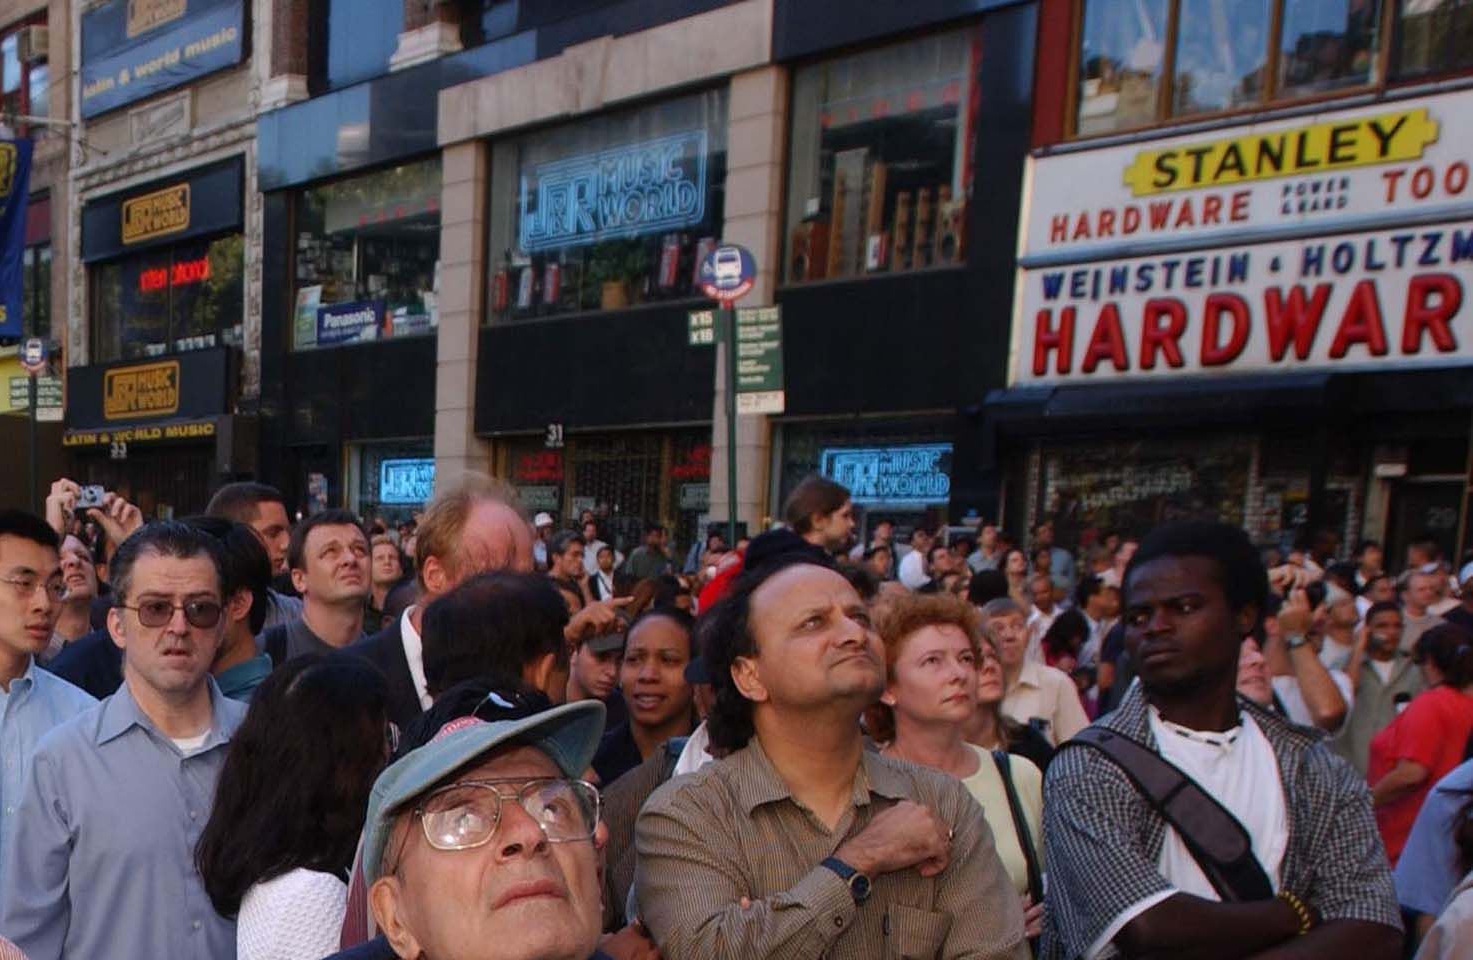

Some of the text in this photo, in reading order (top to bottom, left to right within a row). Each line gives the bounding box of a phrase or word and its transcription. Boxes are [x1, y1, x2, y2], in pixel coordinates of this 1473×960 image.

[118, 68, 130, 85] &
[134, 48, 180, 78] world
[185, 26, 237, 58] music
[598, 143, 684, 195] MUSIC
[1152, 115, 1409, 189] STANLEY
[526, 170, 596, 236] J&R
[598, 181, 697, 229] WORLD
[1282, 176, 1351, 198] POWER
[1050, 191, 1252, 243] HARDWARE
[1042, 252, 1250, 300] WEINSTEIN
[324, 307, 375, 328] Panasonic
[1032, 273, 1463, 376] HARDWAR
[63, 433, 97, 446] LATIN
[166, 422, 215, 438] MUSIC
[548, 424, 564, 441] 31
[879, 450, 942, 473] MUSIC
[879, 472, 951, 496] WORLD
